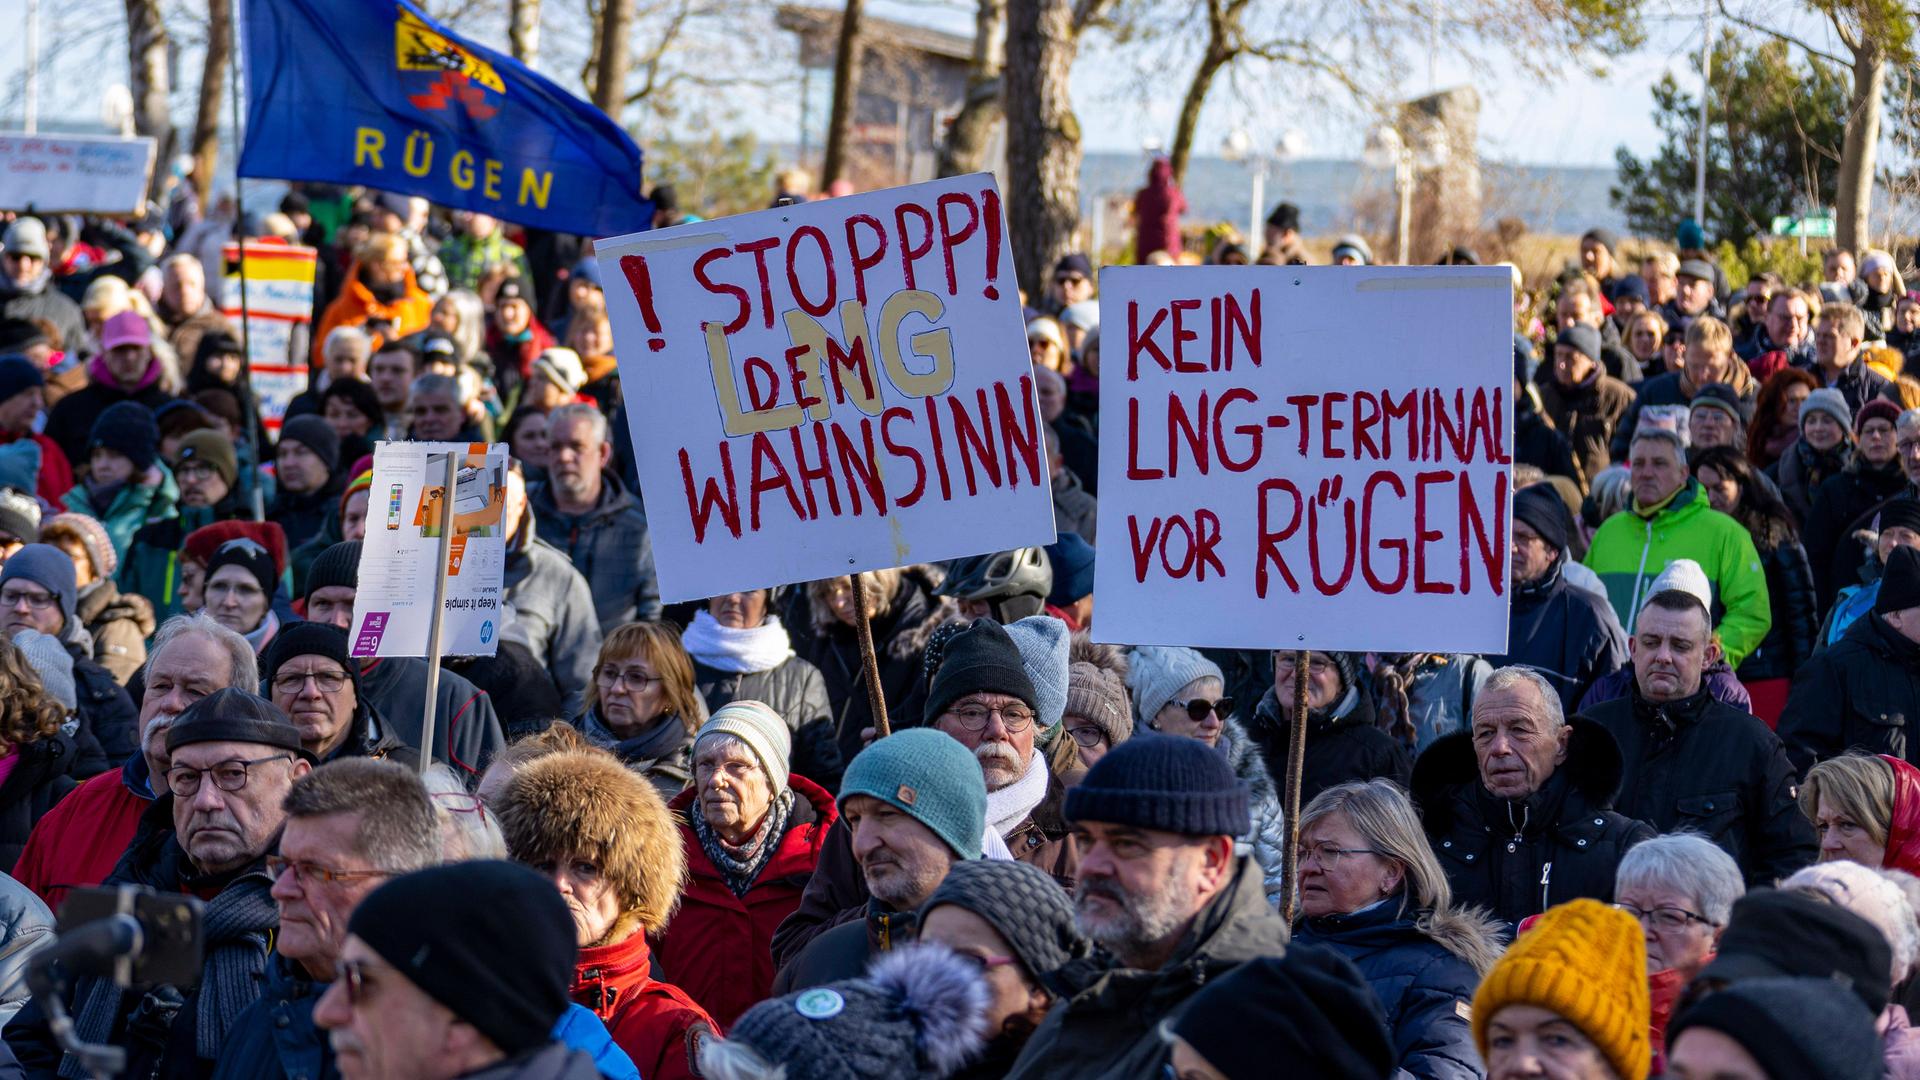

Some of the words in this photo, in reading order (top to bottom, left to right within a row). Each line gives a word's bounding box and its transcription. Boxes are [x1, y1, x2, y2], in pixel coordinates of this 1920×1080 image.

[354, 126, 554, 209] RÜGEN
[620, 254, 666, 352] !
[692, 188, 1001, 335] STOPPP!
[703, 289, 956, 438] LNG
[744, 335, 875, 411] DEM
[1127, 287, 1262, 381] KEIN
[678, 374, 1041, 544] WAHNSINN
[1127, 386, 1512, 481] LNG-TERMINAL
[1127, 508, 1225, 583] VOR
[1255, 470, 1507, 599] RÜGEN
[445, 597, 469, 611] simple
[470, 599, 477, 611] it
[478, 597, 497, 610] Keep
[481, 620, 493, 644] hp
